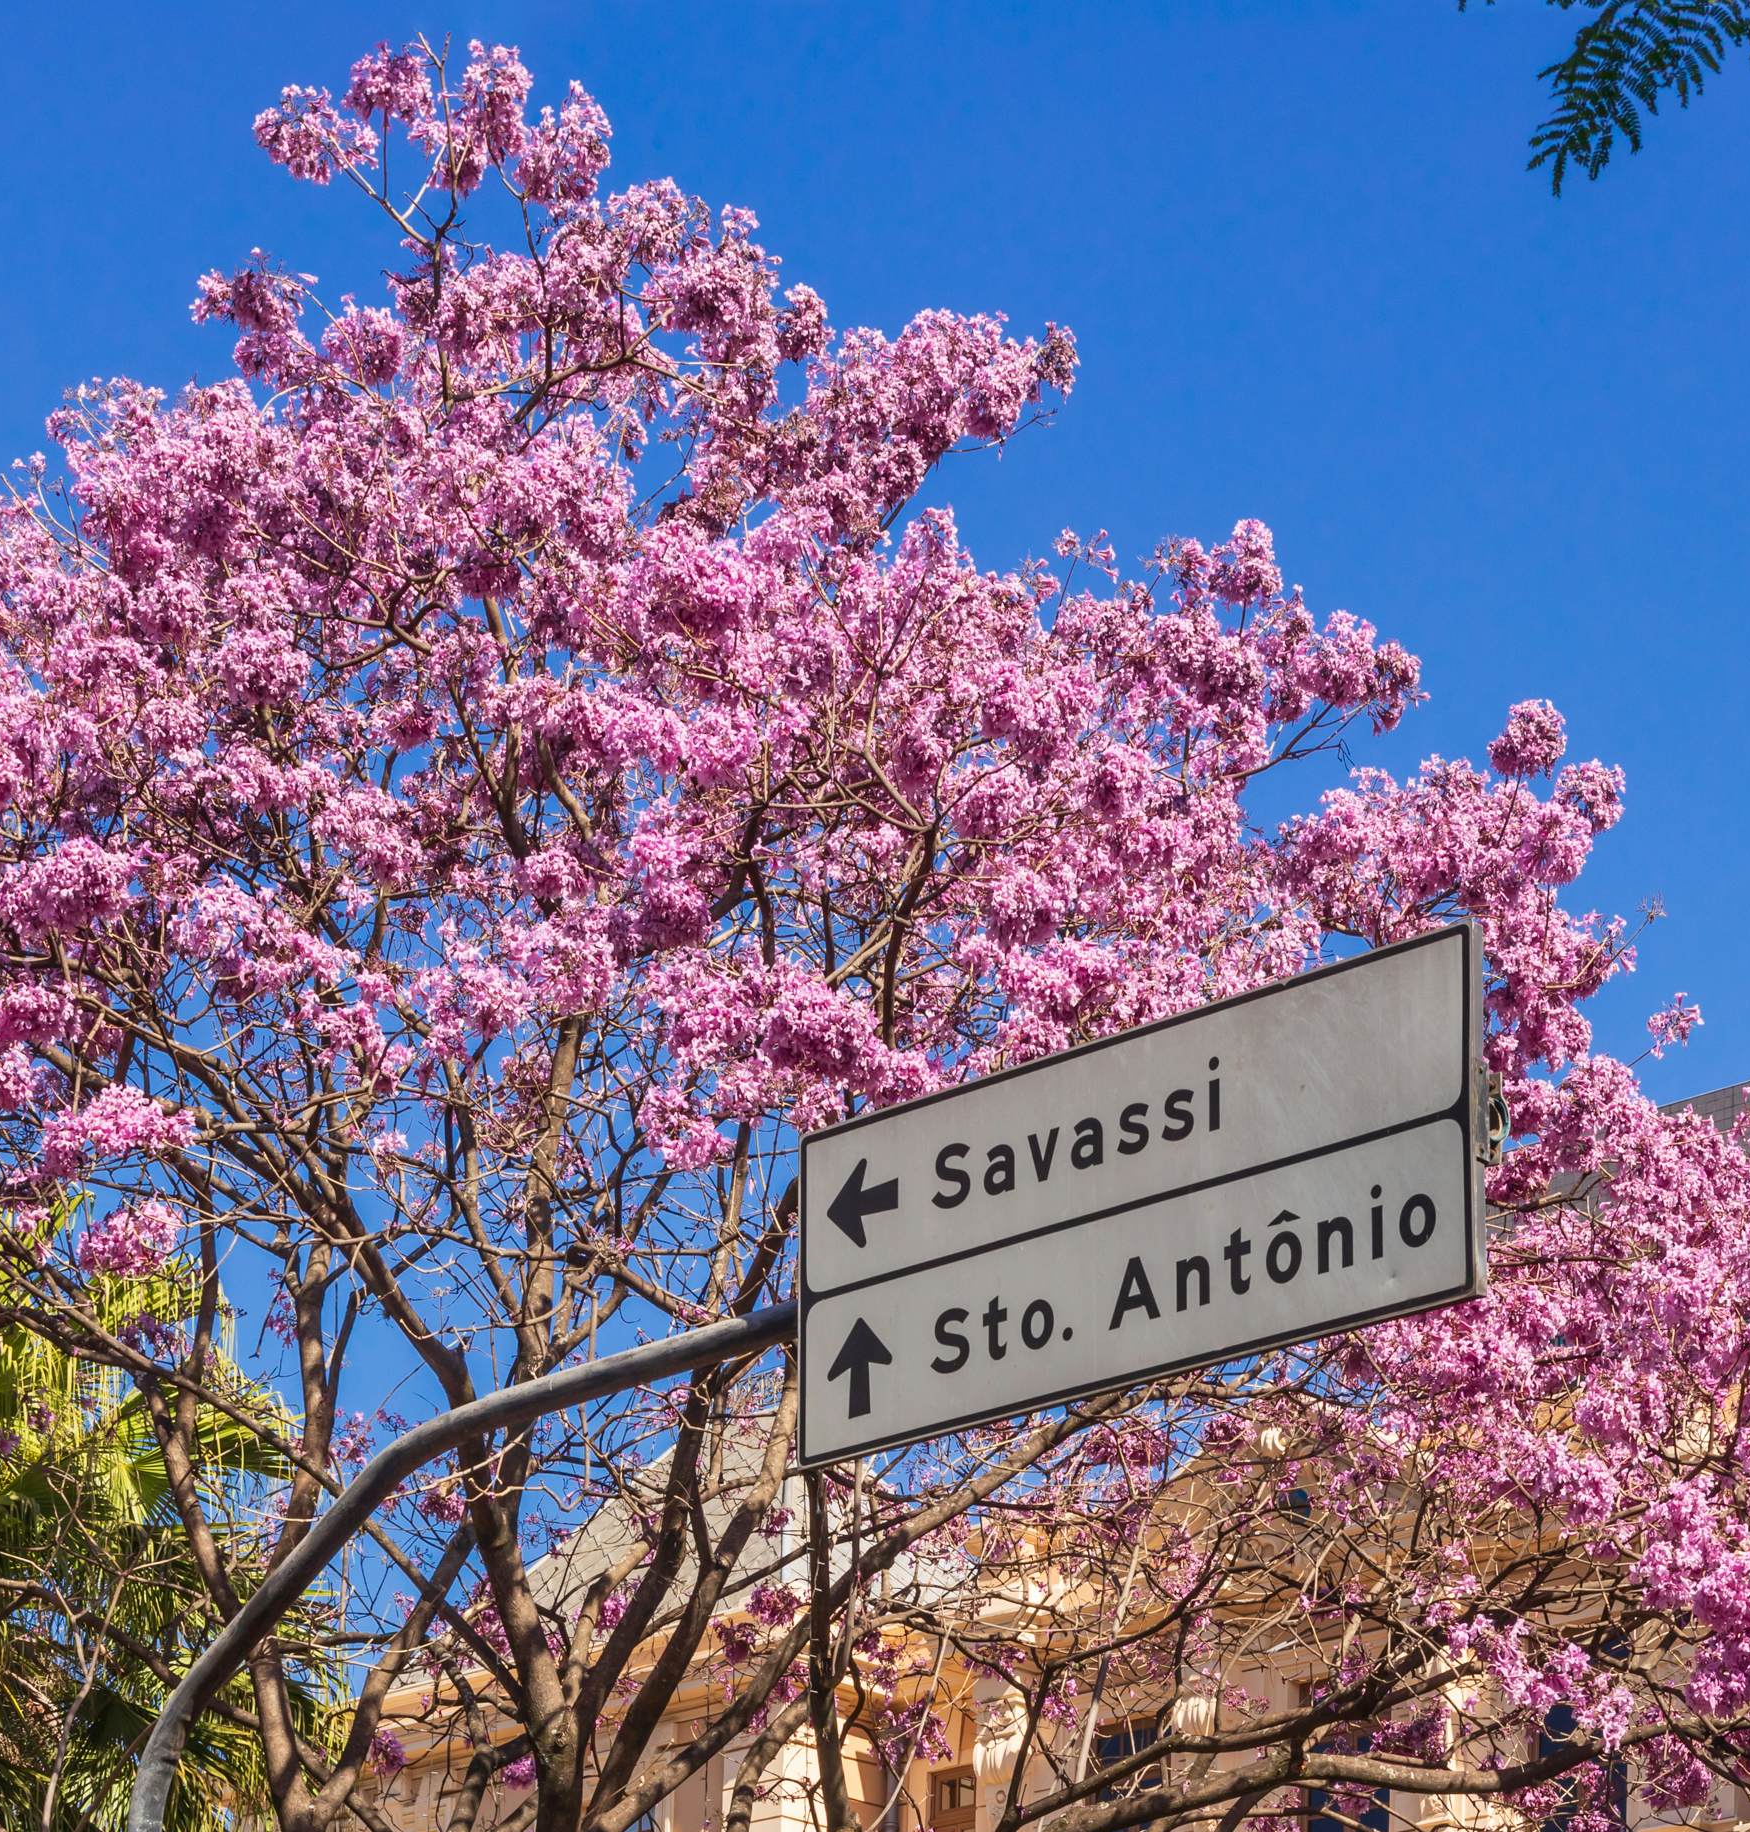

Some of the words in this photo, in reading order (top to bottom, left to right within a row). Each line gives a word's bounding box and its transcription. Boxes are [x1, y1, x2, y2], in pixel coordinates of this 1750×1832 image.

[931, 1056, 1222, 1209] Savassi
[929, 1294, 1074, 1375] Sto.
[1108, 1183, 1438, 1331] Antônio
